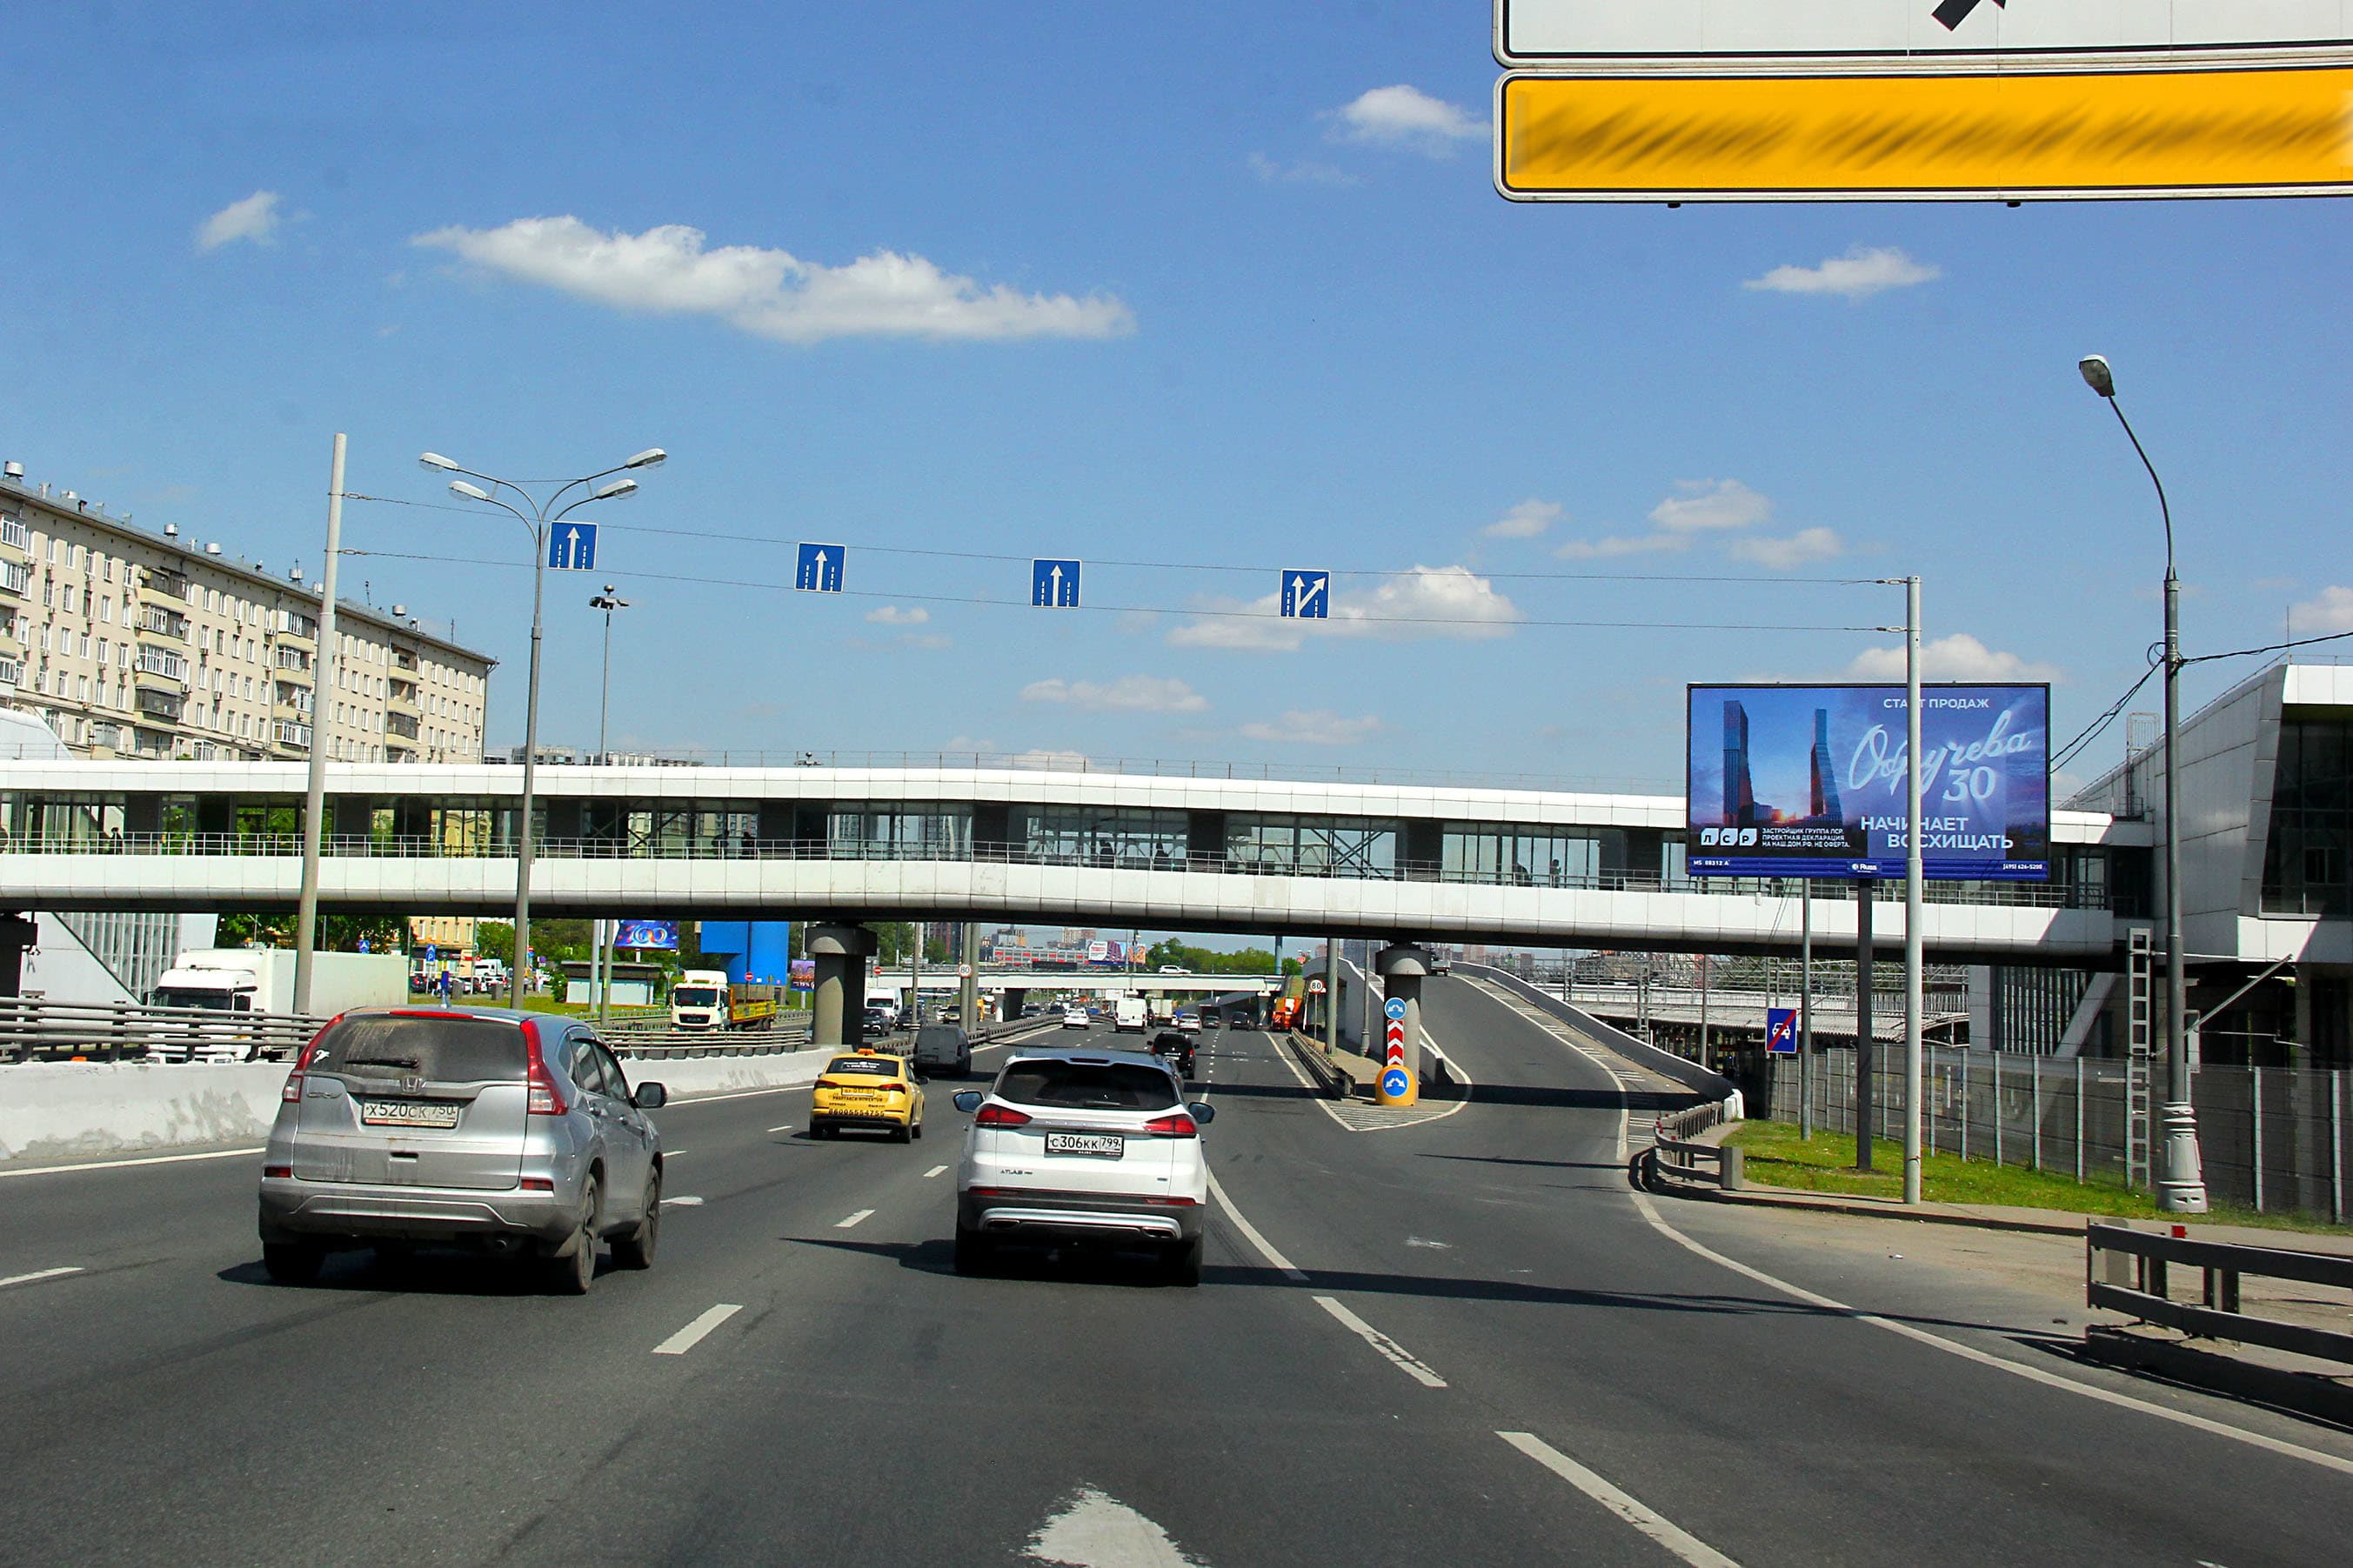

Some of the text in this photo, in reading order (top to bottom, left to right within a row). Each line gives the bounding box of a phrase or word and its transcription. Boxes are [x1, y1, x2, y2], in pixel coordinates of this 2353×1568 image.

[1883, 698, 1989, 710] СТАТ ПРОДАЖ
[1942, 766, 1996, 801] 30
[1311, 981, 1321, 990] 80
